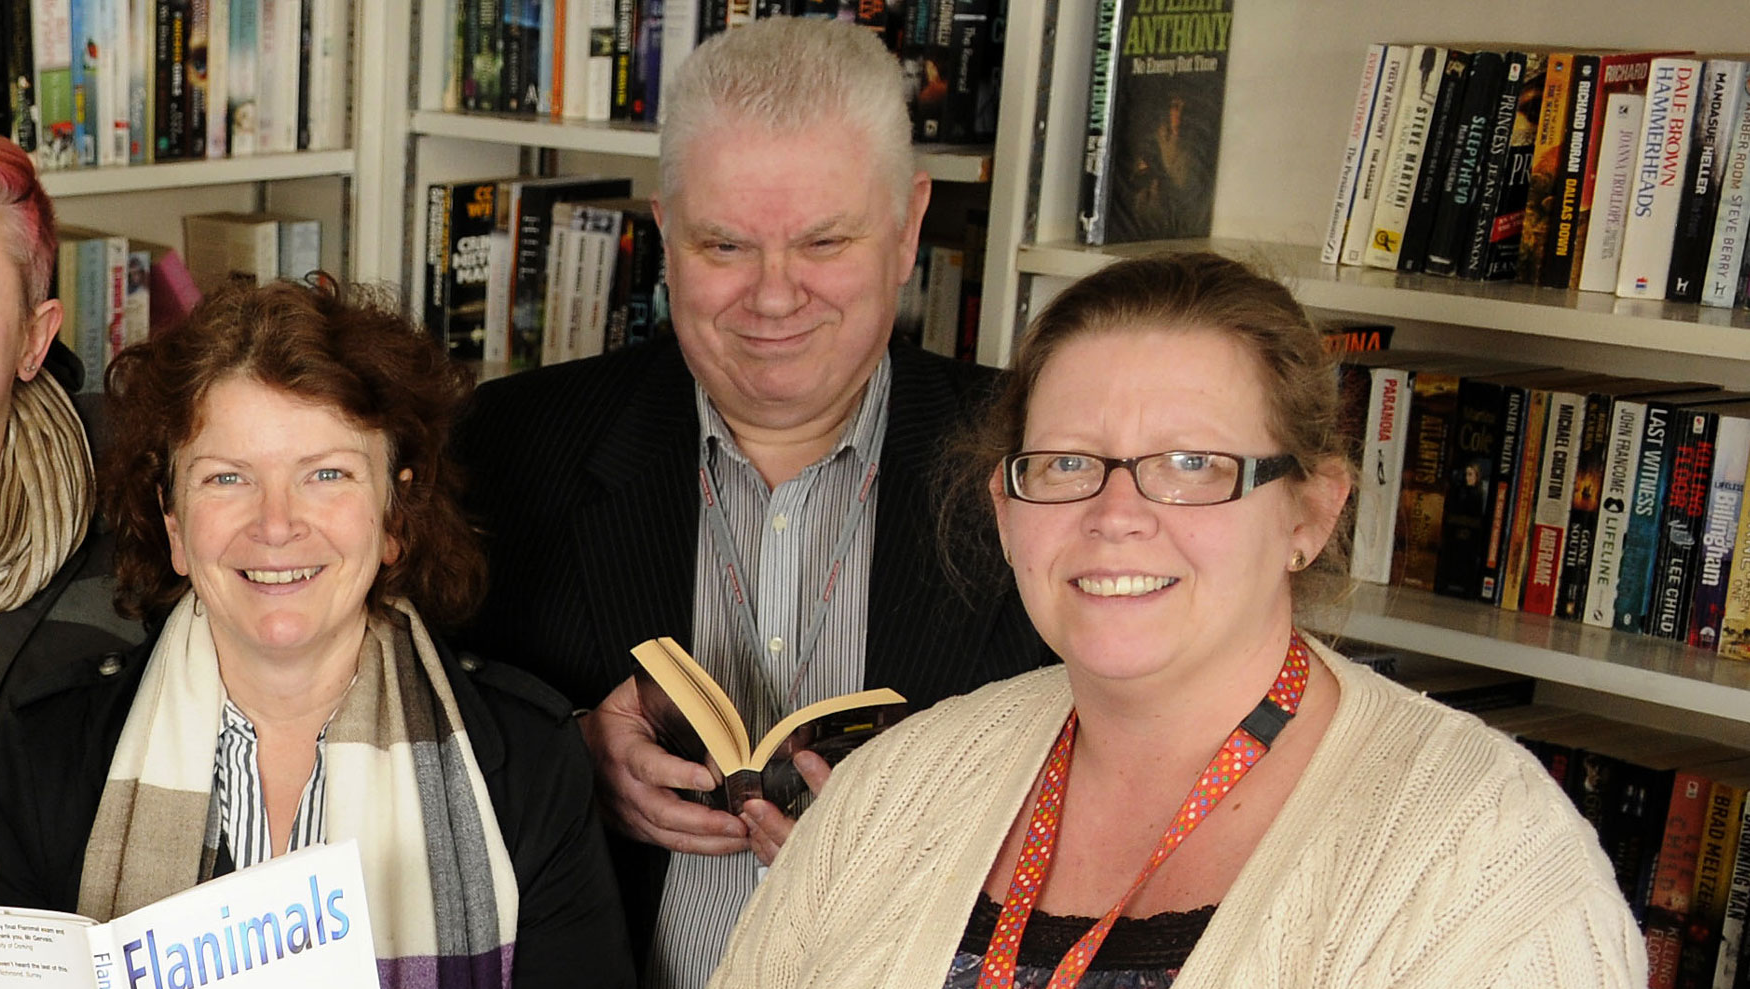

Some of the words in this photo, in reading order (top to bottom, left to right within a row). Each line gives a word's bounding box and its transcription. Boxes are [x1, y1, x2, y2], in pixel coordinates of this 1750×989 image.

[1124, 12, 1232, 54] ANTHONY
[1132, 57, 1146, 74] No
[1147, 57, 1175, 76] Enemy
[1176, 55, 1193, 72] But
[1194, 55, 1218, 71] Time
[1604, 63, 1648, 83] RICHARD
[1575, 80, 1591, 129] RICHARD
[1670, 67, 1692, 114] DALE
[1704, 72, 1727, 145] MANDASUE
[1408, 106, 1428, 146] STEVE
[1617, 130, 1633, 165] JOANNA
[1635, 66, 1674, 218] HAMMERHEADS
[1567, 131, 1583, 173] MORAN
[1660, 117, 1684, 187] BROWN
[1694, 144, 1714, 195] HELLER
[1394, 152, 1417, 209] MARTINI
[1560, 178, 1577, 221] DALLAS
[1606, 167, 1628, 230] TROLLOPE
[1555, 222, 1570, 257] DOWN
[1378, 379, 1398, 443] PARANOIA
[1554, 403, 1574, 448] MICHAEL
[1620, 408, 1635, 437] JOHN
[1646, 408, 1668, 448] LAST
[1415, 414, 1444, 485] ATLANTIS
[1459, 424, 1494, 452] Cole
[1547, 449, 1569, 501] CRICHTON
[1609, 439, 1632, 494] FRANCOME
[1634, 450, 1663, 517] WITNESS
[1669, 445, 1693, 508] FLOOR
[1687, 440, 1713, 518] KILLING
[1534, 527, 1558, 587] AIRFRAME
[1565, 522, 1581, 568] SOUTH
[1579, 529, 1590, 567] GONE
[1596, 516, 1619, 586] LIFELINE
[1701, 491, 1736, 586] Billingham
[1671, 558, 1683, 583] LEE
[1660, 585, 1680, 634] CHILD
[1707, 794, 1732, 840] BRAD
[1726, 892, 1750, 922] MAN
[1658, 925, 1681, 986] KILLING
